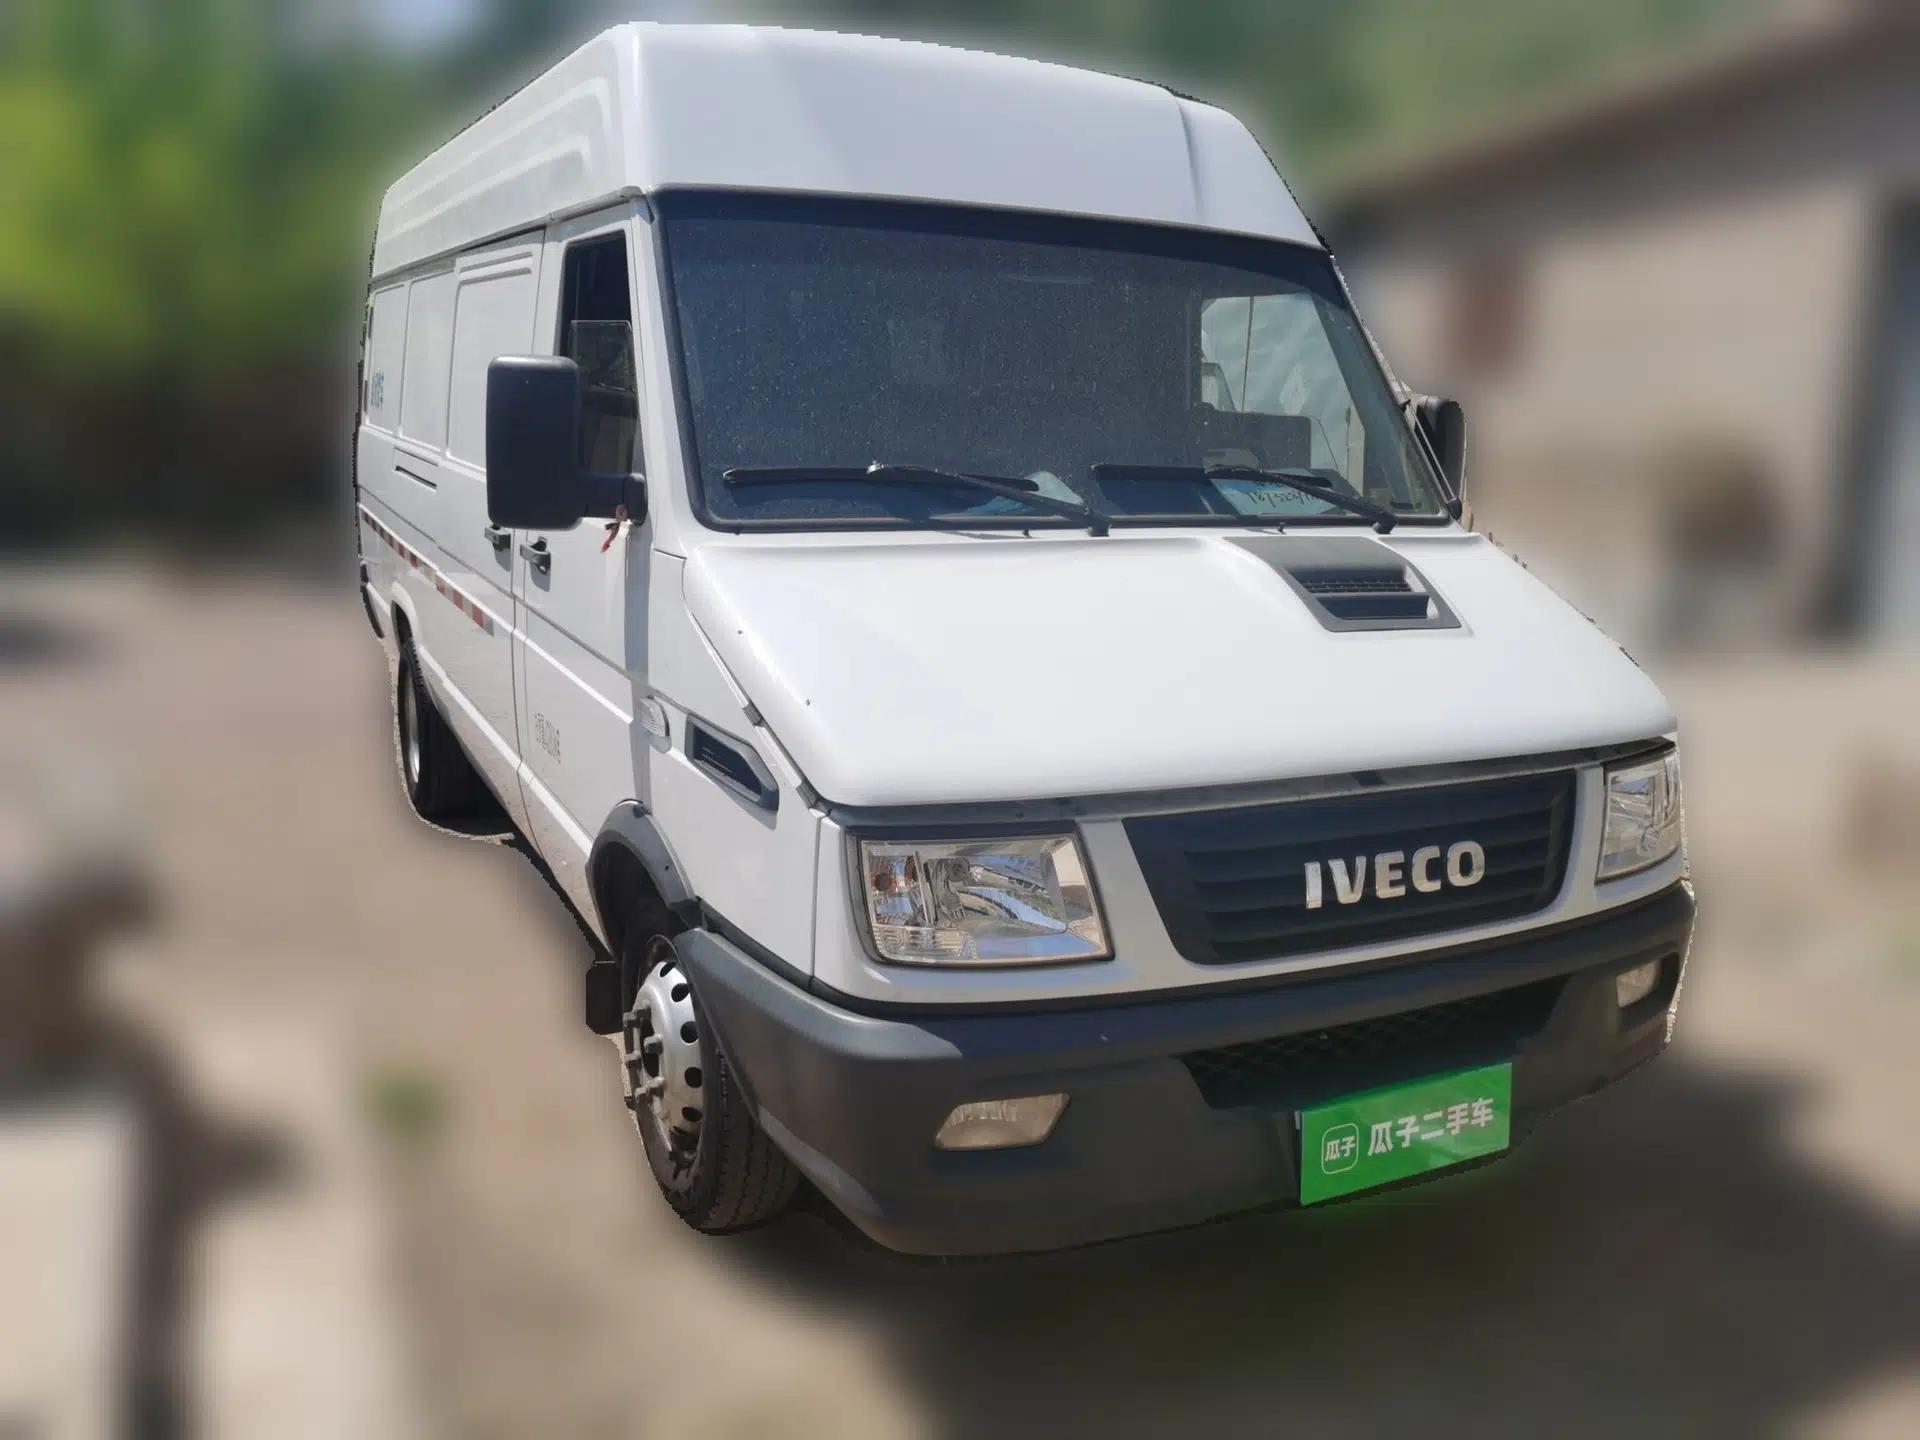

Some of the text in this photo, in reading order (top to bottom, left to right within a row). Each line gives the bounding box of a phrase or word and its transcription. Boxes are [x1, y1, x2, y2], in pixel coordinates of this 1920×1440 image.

[1304, 840, 1486, 909] IVECO
[1324, 1097, 1494, 1162] 瓜子 瓜子二手车
